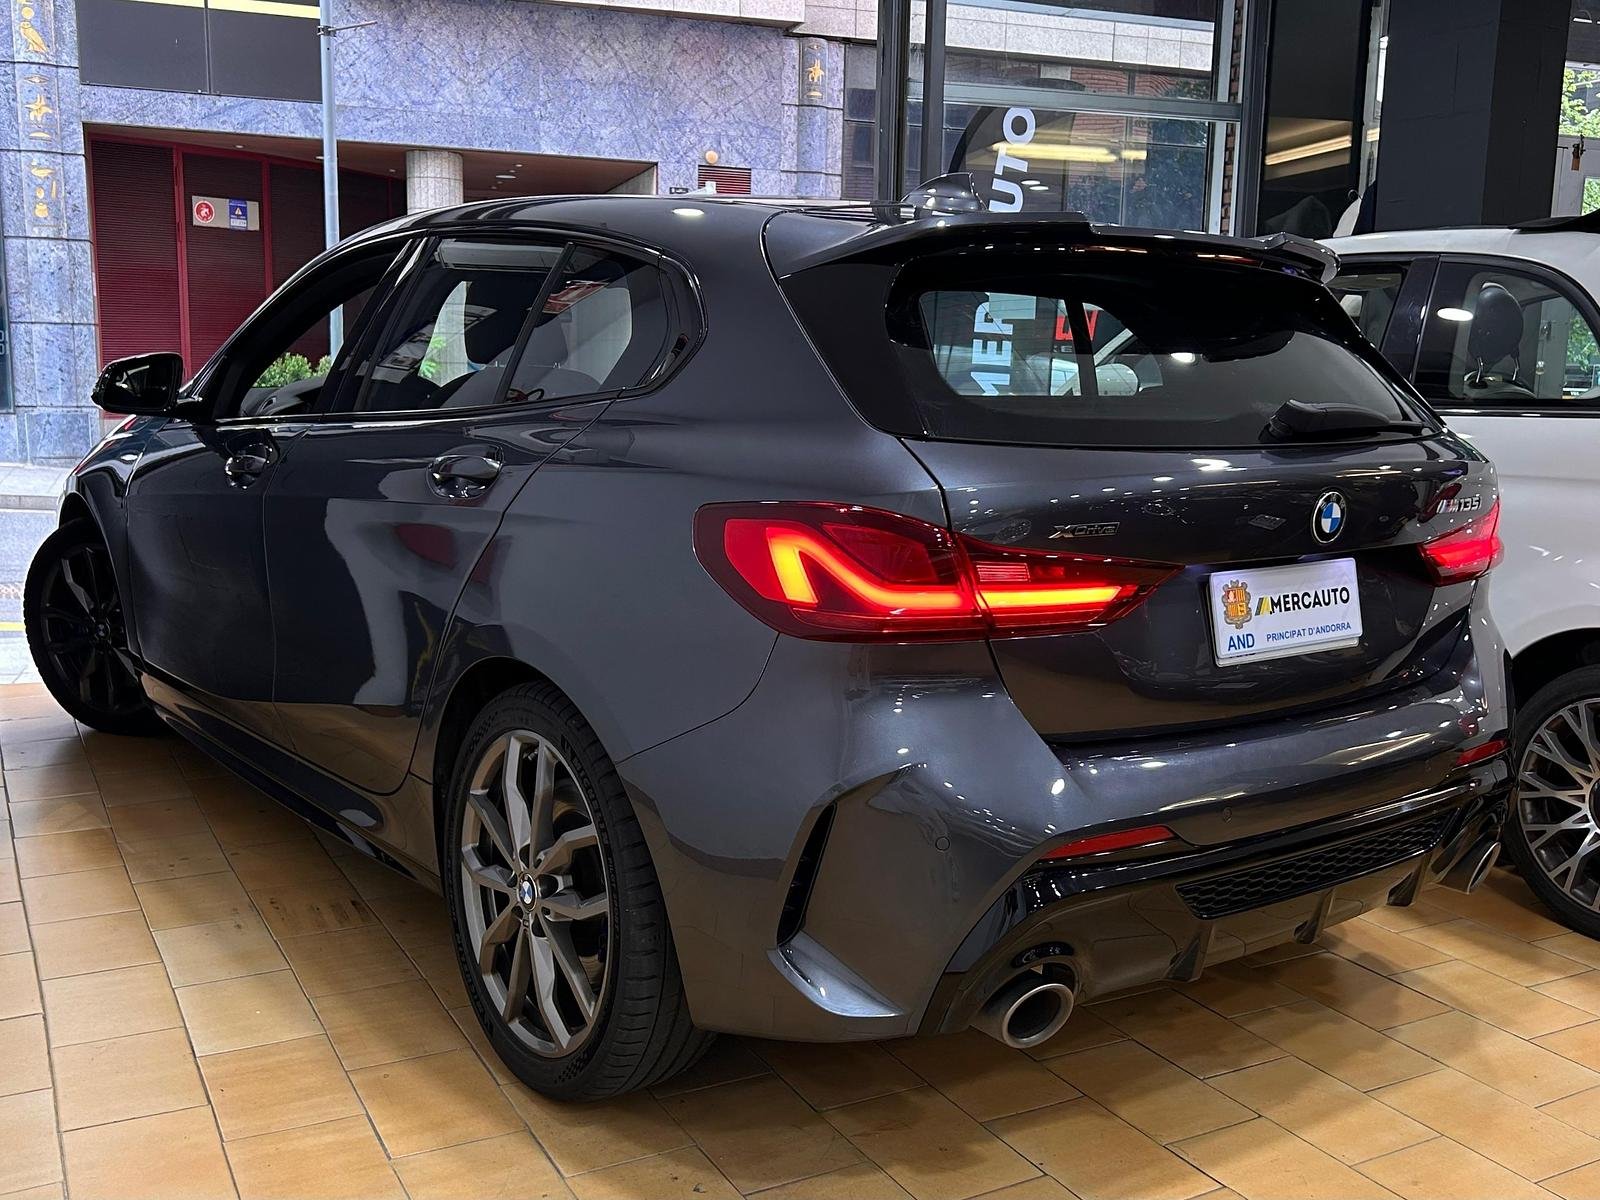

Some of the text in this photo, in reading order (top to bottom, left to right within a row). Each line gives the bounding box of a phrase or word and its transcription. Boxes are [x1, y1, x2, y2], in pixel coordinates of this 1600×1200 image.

[1270, 587, 1350, 614] MERCAUTO
[1228, 633, 1255, 651] AND
[1266, 622, 1351, 642] PRINCIPAT D'ANDORRA
